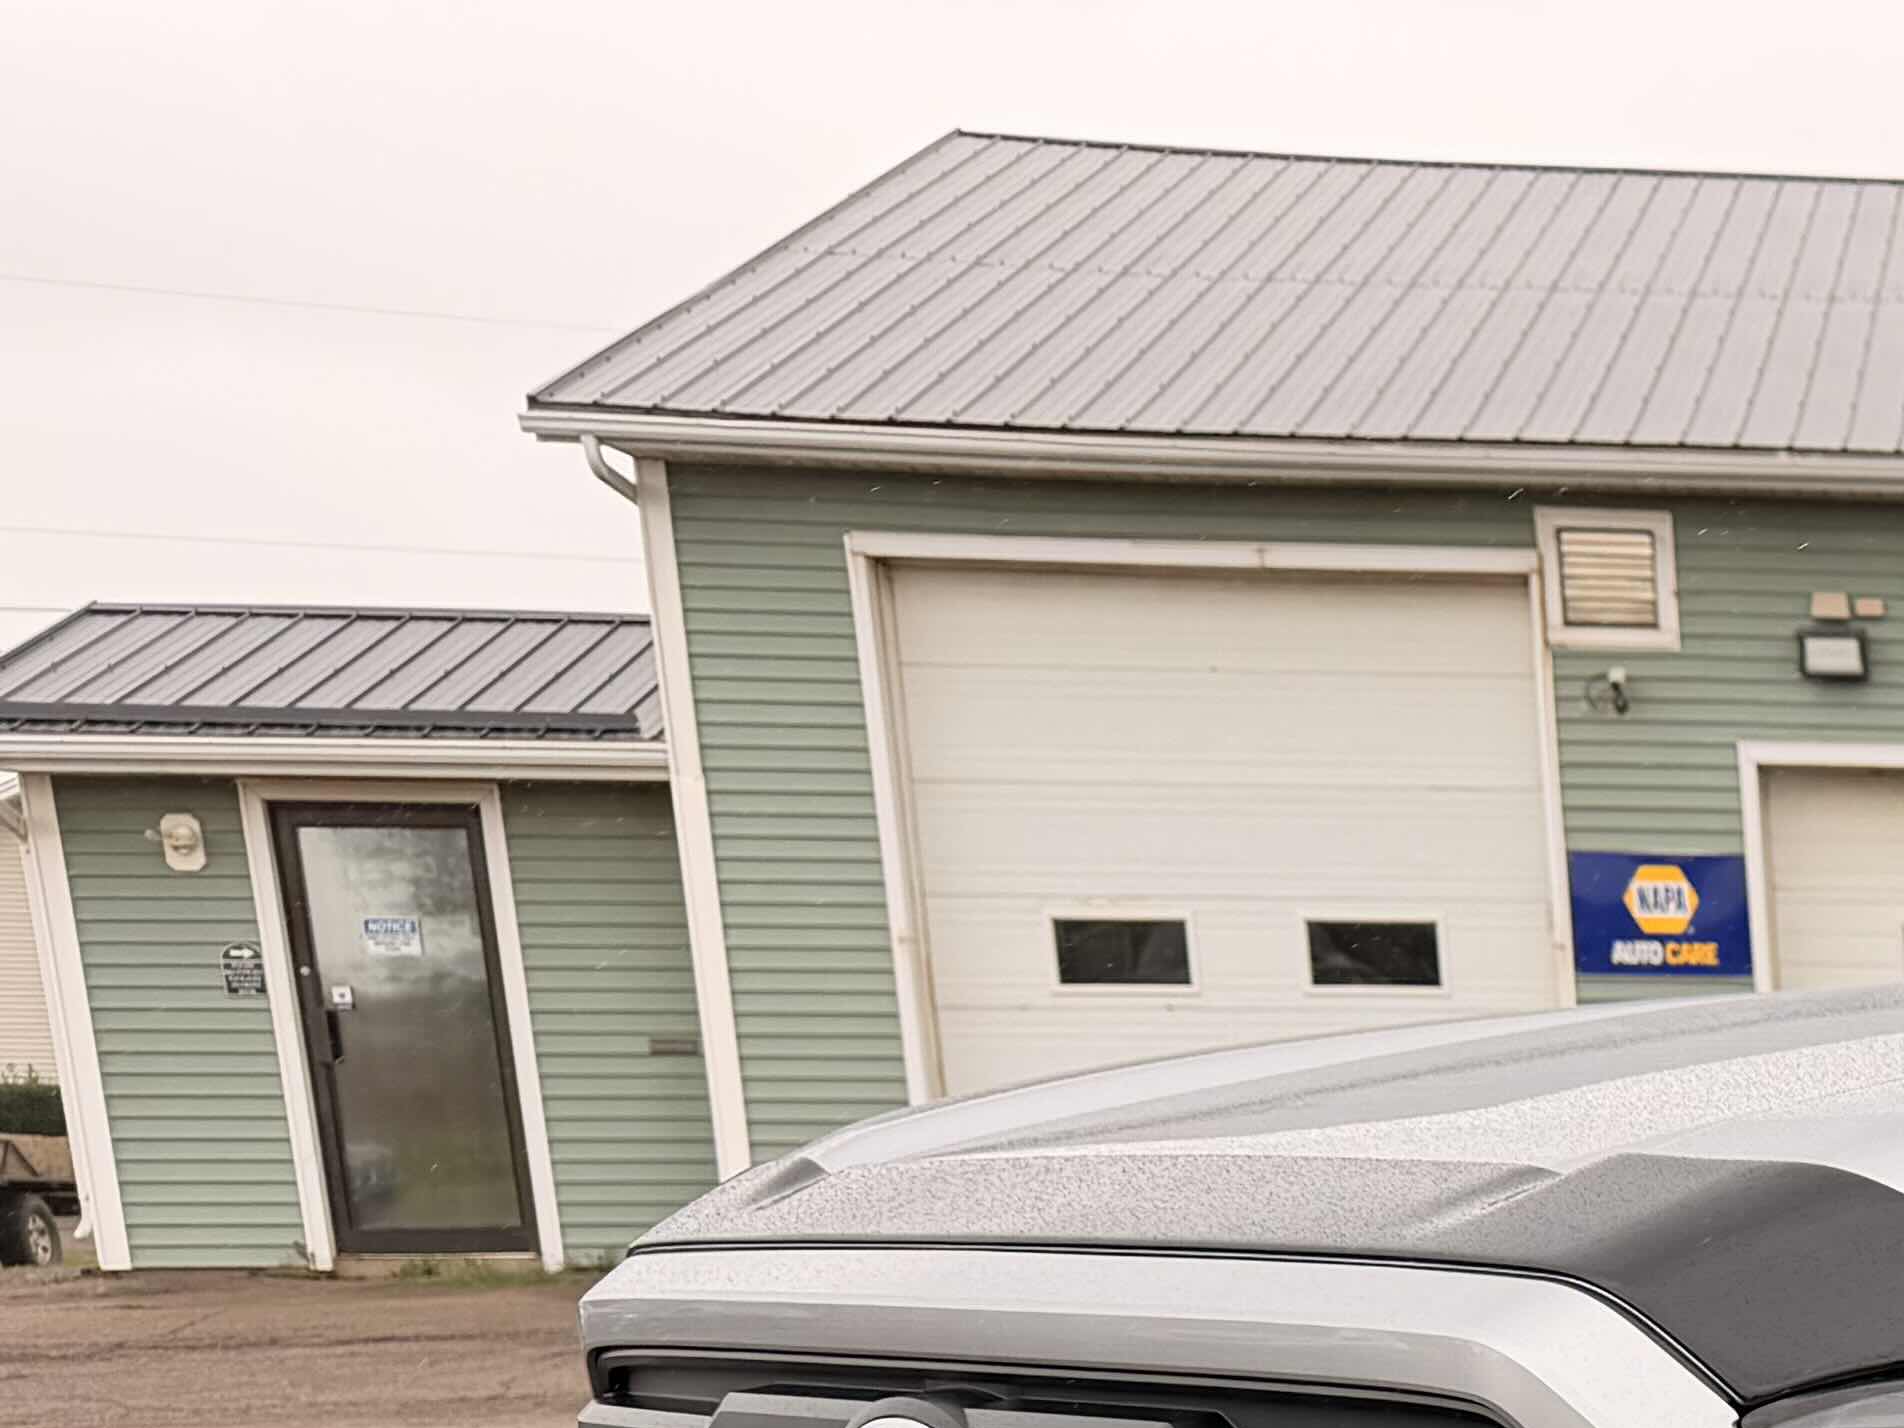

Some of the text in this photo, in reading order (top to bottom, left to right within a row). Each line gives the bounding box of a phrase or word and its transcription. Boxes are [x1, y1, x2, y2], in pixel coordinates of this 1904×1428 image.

[1637, 884, 1689, 914] NAPA
[1611, 940, 1720, 966] AUTO CARE
